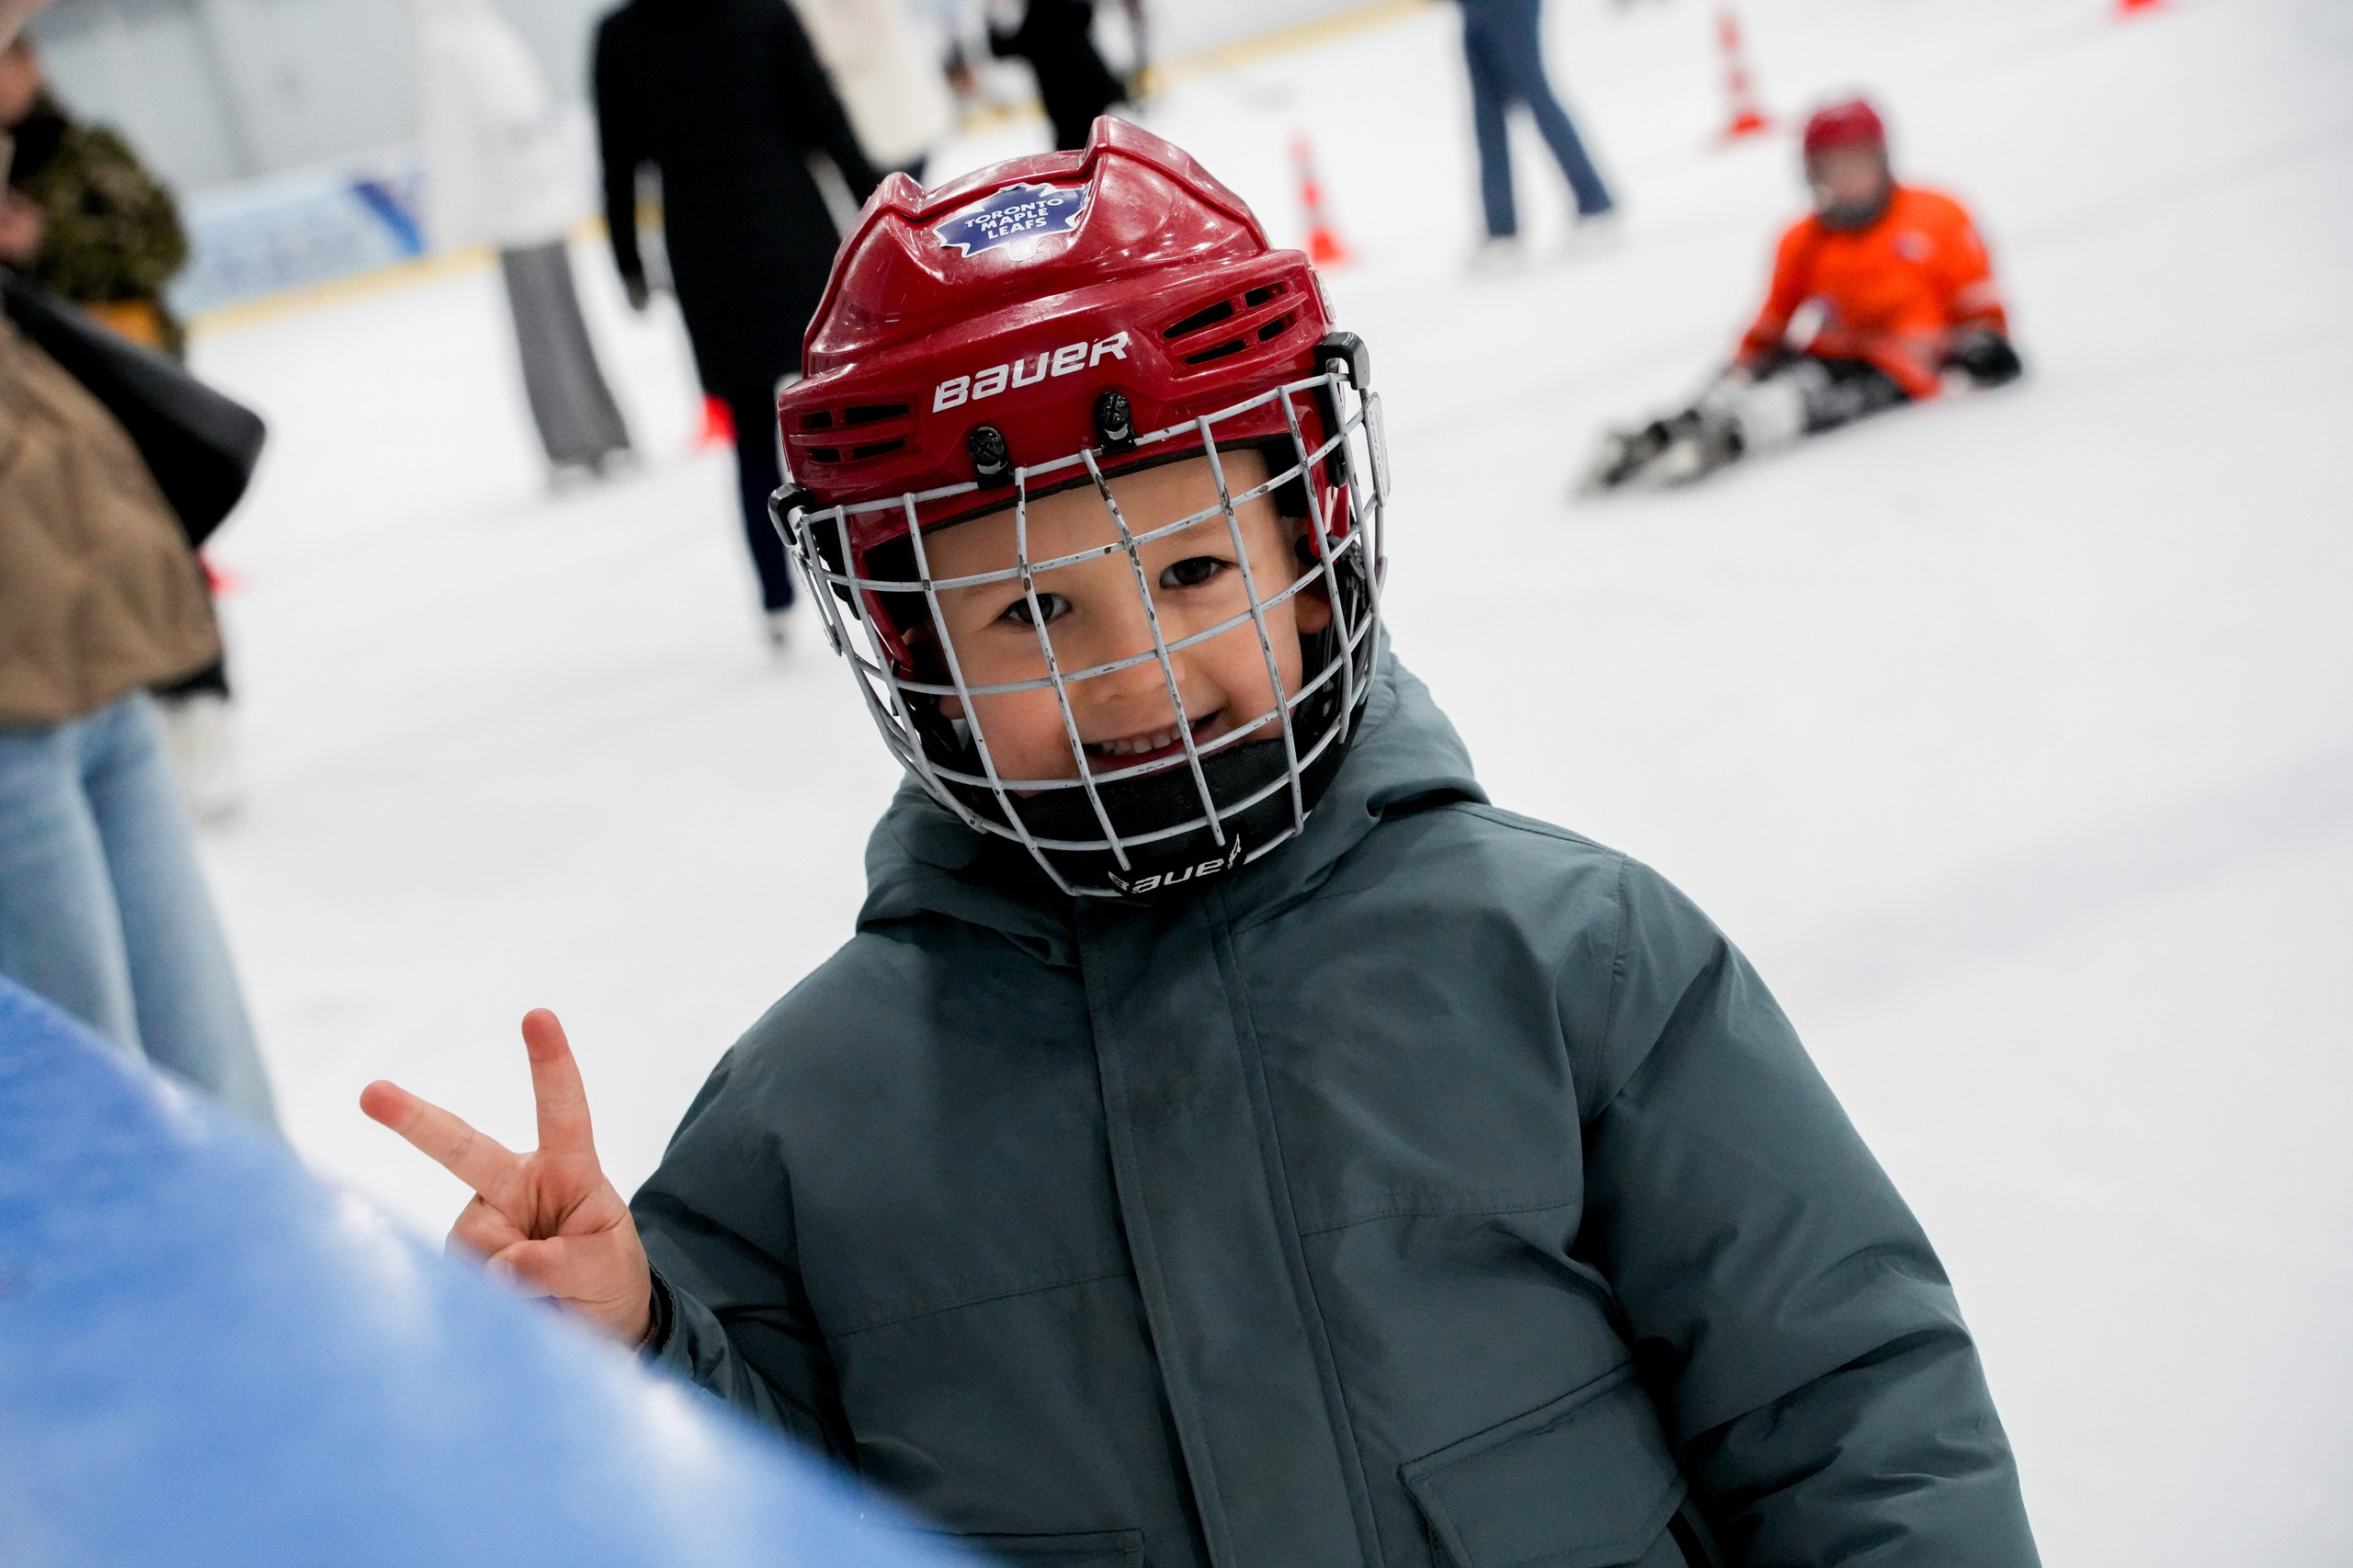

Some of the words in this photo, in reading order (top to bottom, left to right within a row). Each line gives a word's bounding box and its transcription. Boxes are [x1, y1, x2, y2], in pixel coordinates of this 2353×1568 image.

[965, 199, 1063, 228] TORONTO
[981, 208, 1049, 232] MAPLE
[988, 217, 1047, 239] LEAFS
